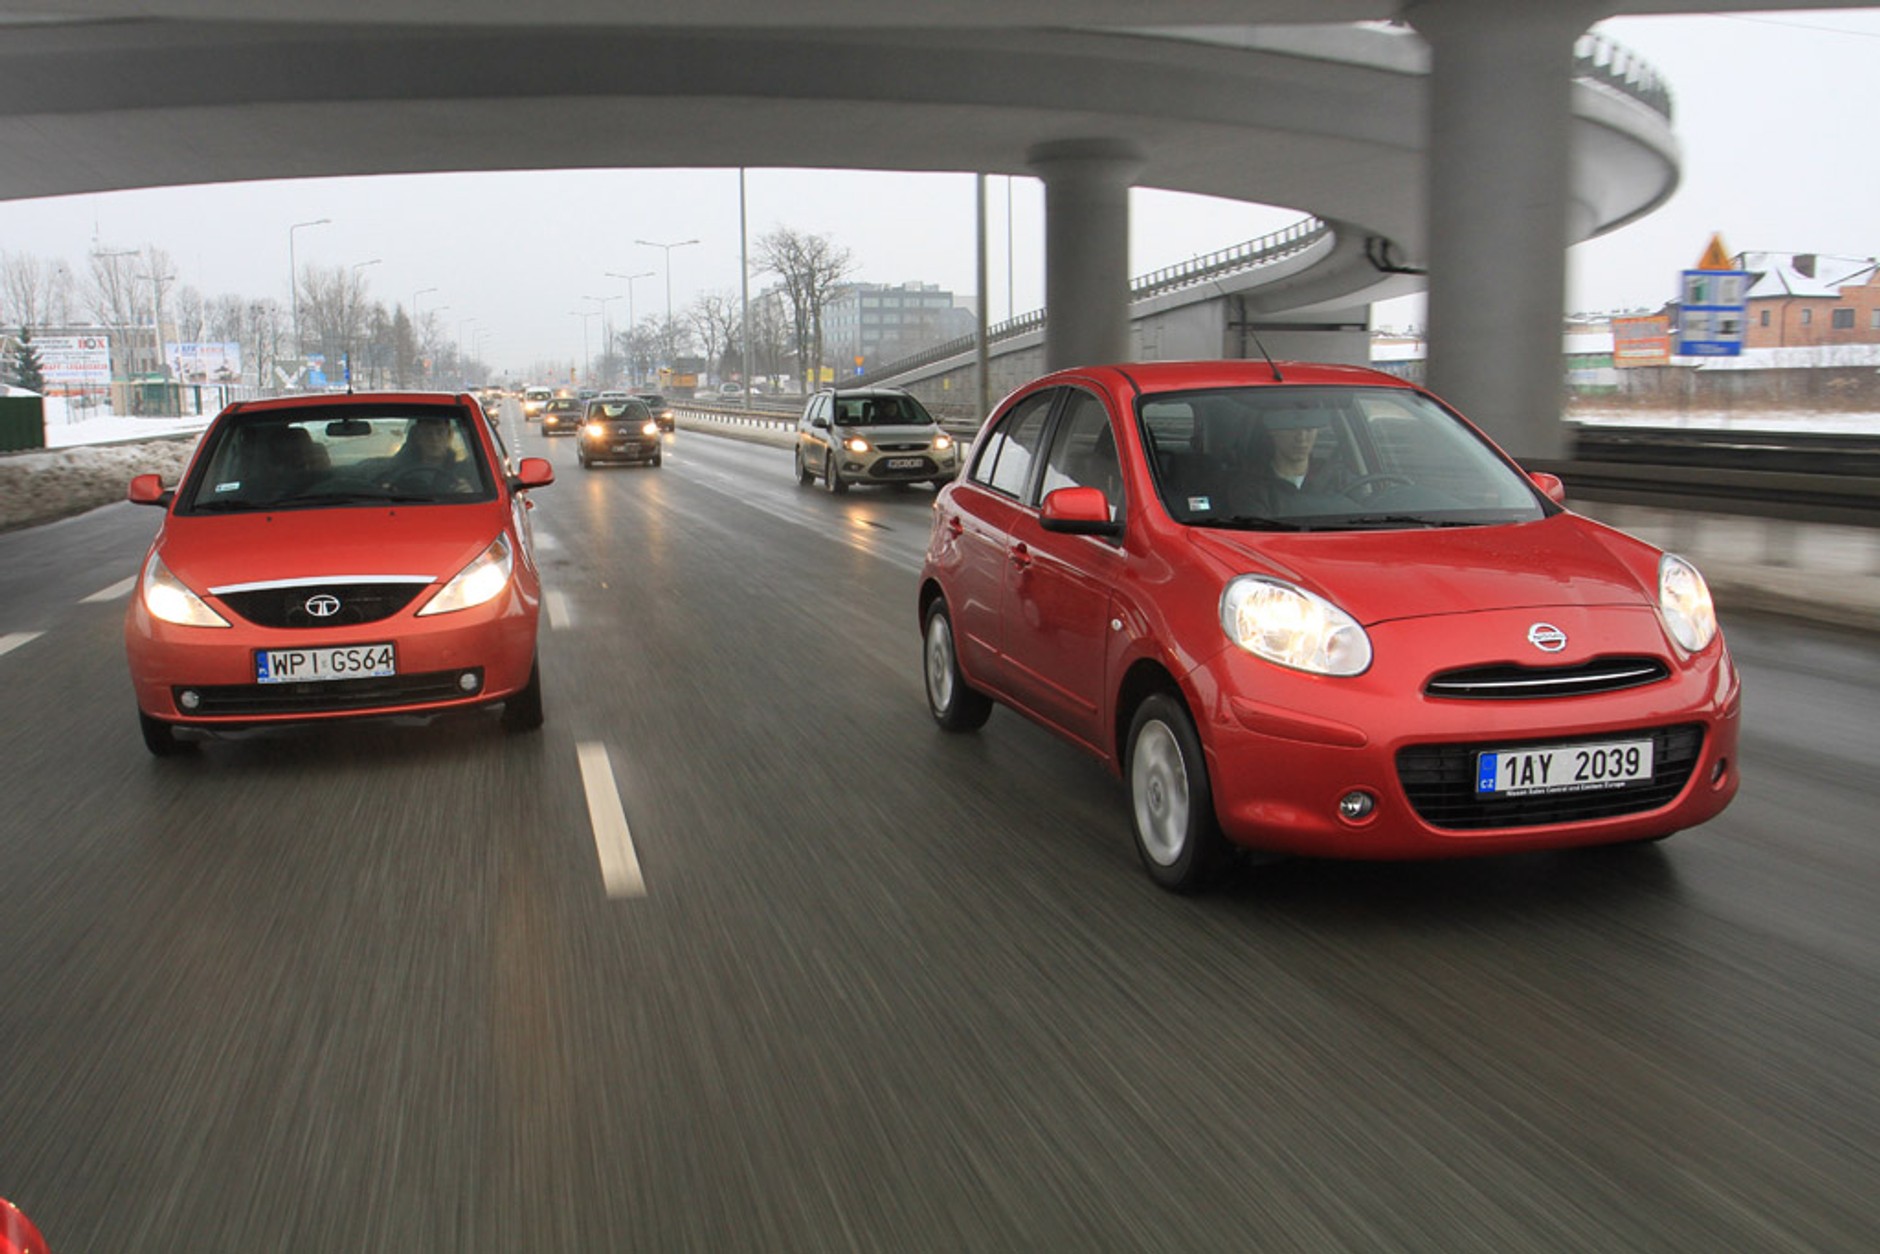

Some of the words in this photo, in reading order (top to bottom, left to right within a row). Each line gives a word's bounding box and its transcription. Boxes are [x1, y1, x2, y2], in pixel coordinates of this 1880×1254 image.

[331, 647, 393, 673] GS64
[1505, 753, 1552, 786] 1AY
[1574, 747, 1640, 780] 2039
[1480, 778, 1494, 789] CZ
